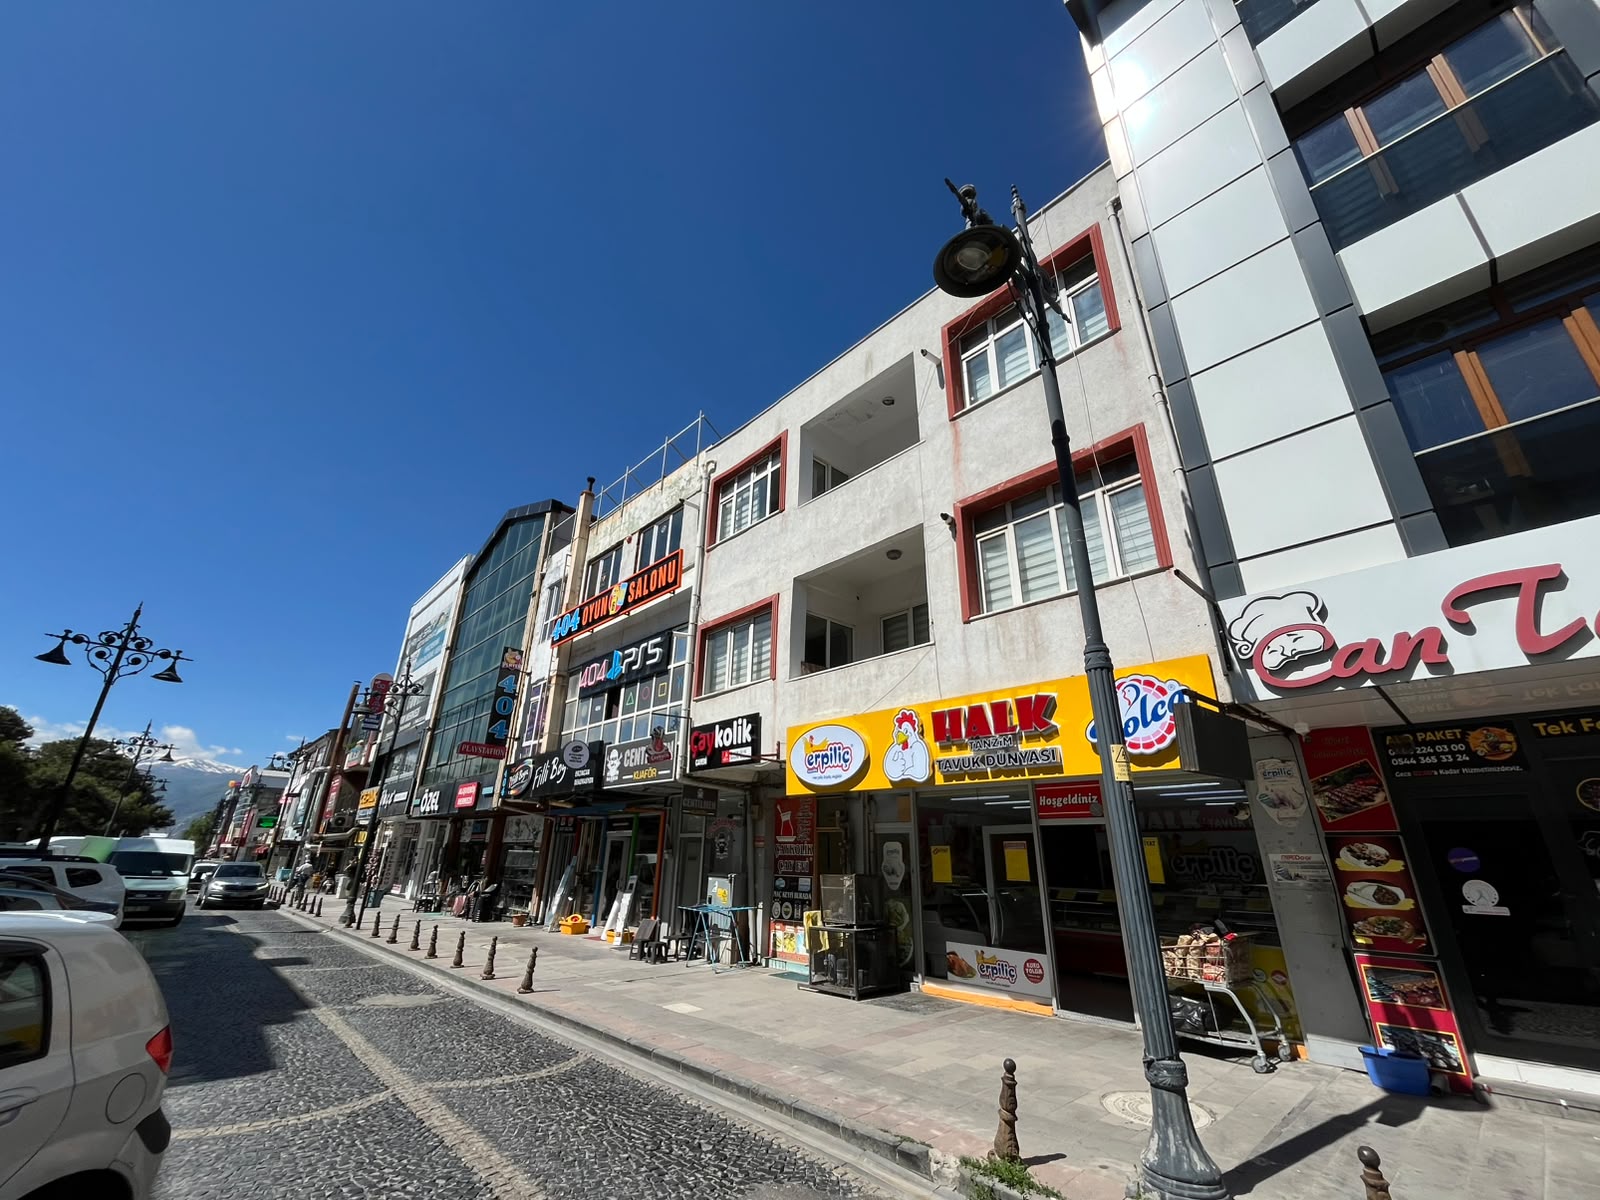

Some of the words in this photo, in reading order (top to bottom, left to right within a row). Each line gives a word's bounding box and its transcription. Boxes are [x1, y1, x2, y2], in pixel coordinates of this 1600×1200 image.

[552, 608, 581, 640] 404
[582, 595, 609, 626] OYUN
[628, 560, 677, 603] SALONU
[1252, 621, 1448, 689] Can
[1441, 563, 1600, 655] T
[579, 659, 608, 689] 404
[622, 637, 663, 673] PS5
[489, 674, 517, 740] 404
[931, 693, 1058, 743] HALK
[1088, 683, 1187, 742] olca
[690, 718, 752, 759] Çaykolik
[1415, 729, 1463, 742] PAKET
[1532, 720, 1577, 736] Tek
[461, 744, 506, 757] PLAYSTATION
[807, 745, 850, 768] erpiliç
[936, 754, 985, 772] TAVUK
[985, 748, 1057, 768] DÜNYASI
[1416, 745, 1434, 755] 224
[1435, 744, 1449, 753] 03
[1451, 743, 1466, 752] 00
[1419, 755, 1437, 764] 365
[1440, 754, 1454, 763] 33
[1456, 754, 1470, 762] 24
[633, 767, 657, 781] KUAFÖR
[1039, 793, 1098, 808] Hoşgeldiniz
[979, 962, 1016, 978] erpiliç
